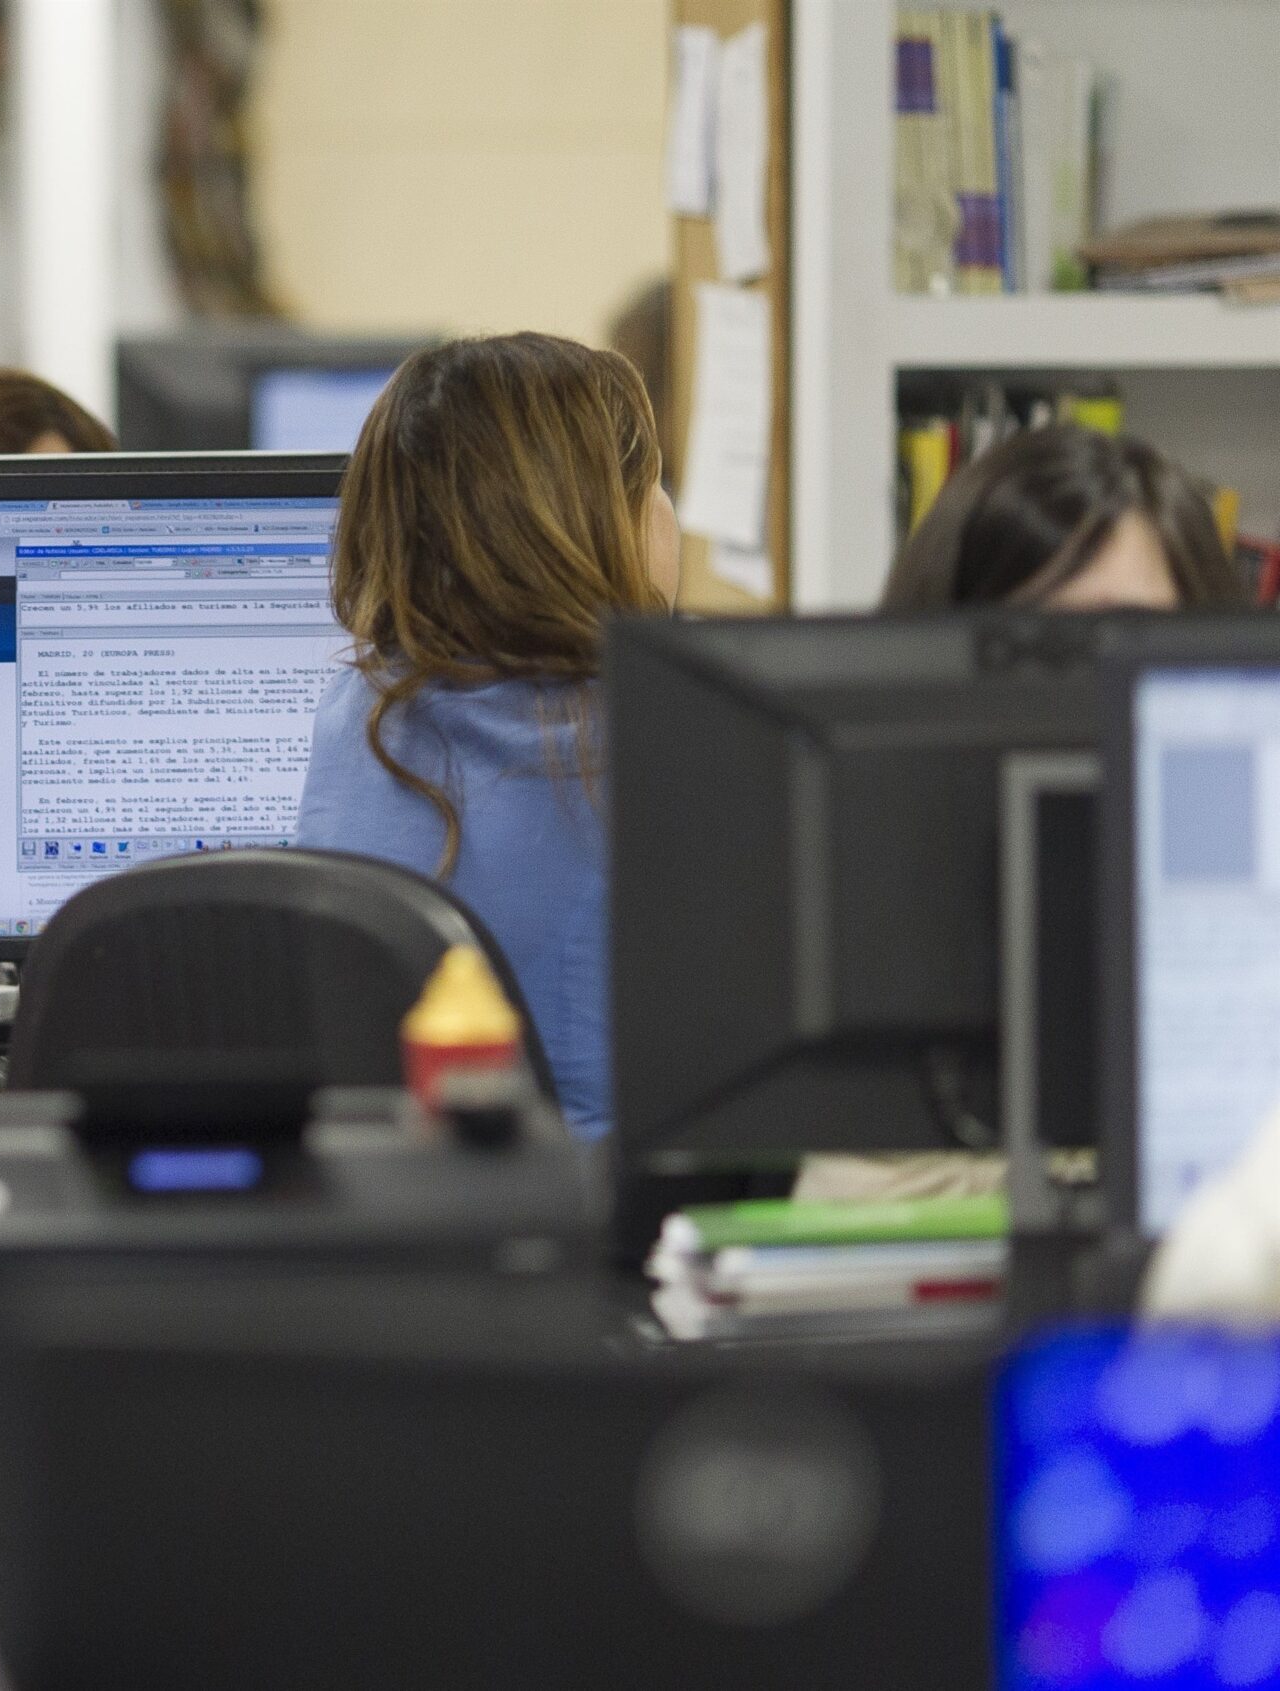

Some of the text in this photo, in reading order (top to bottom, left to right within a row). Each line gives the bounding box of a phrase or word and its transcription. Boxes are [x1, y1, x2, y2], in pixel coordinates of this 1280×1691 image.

[271, 601, 321, 610] Seguridad
[38, 650, 76, 658] MADRID,
[110, 668, 177, 678] trabajadores
[293, 667, 337, 676] Segurida
[320, 676, 332, 685] 5,
[105, 689, 144, 697] superar
[171, 687, 193, 696] 1,92
[265, 688, 314, 696] personas,
[149, 699, 166, 707] por
[138, 707, 199, 717] dependiente
[149, 736, 188, 746] explica
[193, 736, 271, 745] principalmente
[276, 737, 293, 745] por
[94, 748, 111, 756] que
[22, 757, 76, 766] afiliados,
[265, 757, 282, 765] que
[22, 768, 71, 776] personas,
[89, 766, 127, 776] implica
[193, 795, 238, 804] agencias
[155, 805, 193, 815] segundo
[45, 816, 67, 824] 1,32
[138, 815, 209, 824] trabajadores,
[216, 814, 254, 824] gracias
